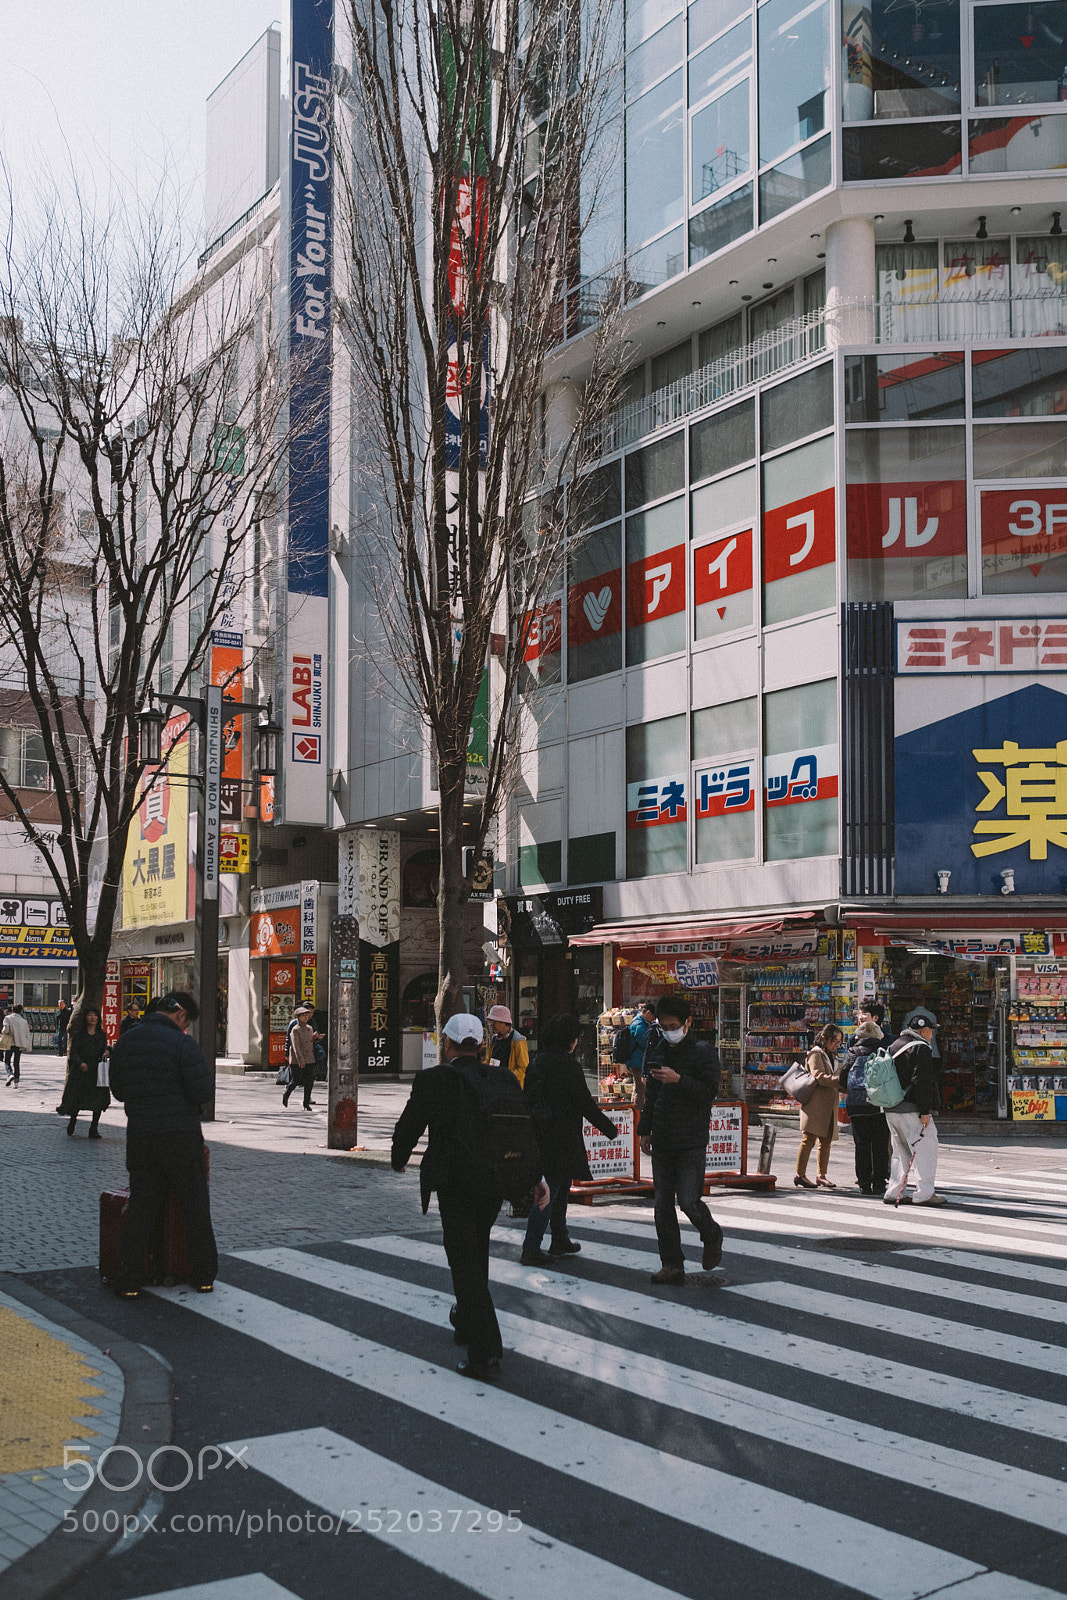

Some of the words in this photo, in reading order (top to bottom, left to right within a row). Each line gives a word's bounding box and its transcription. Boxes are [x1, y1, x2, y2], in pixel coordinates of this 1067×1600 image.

[297, 203, 326, 278] Your
[292, 653, 312, 727] LABI
[313, 681, 322, 728] SHINJUKU
[209, 706, 219, 775] SHINJUKU
[208, 782, 217, 810] MOA
[635, 754, 818, 822] ミネドラッグ
[208, 818, 216, 826] 2
[132, 843, 176, 887] 大黒屋
[206, 832, 215, 881] Avenue
[221, 838, 238, 855] 質
[379, 839, 389, 899] BRAND
[379, 904, 388, 936] OFF
[557, 895, 574, 906] DUTY
[575, 894, 591, 905] FREE
[303, 898, 315, 952] 歯科医院
[1023, 933, 1046, 954] 薬
[678, 973, 720, 987] COUPON
[1037, 964, 1059, 973] VISA
[105, 984, 118, 1037] 買取・預り
[369, 951, 389, 1031] 高価買取
[367, 1056, 390, 1067] B2F
[372, 1037, 386, 1048] 1F
